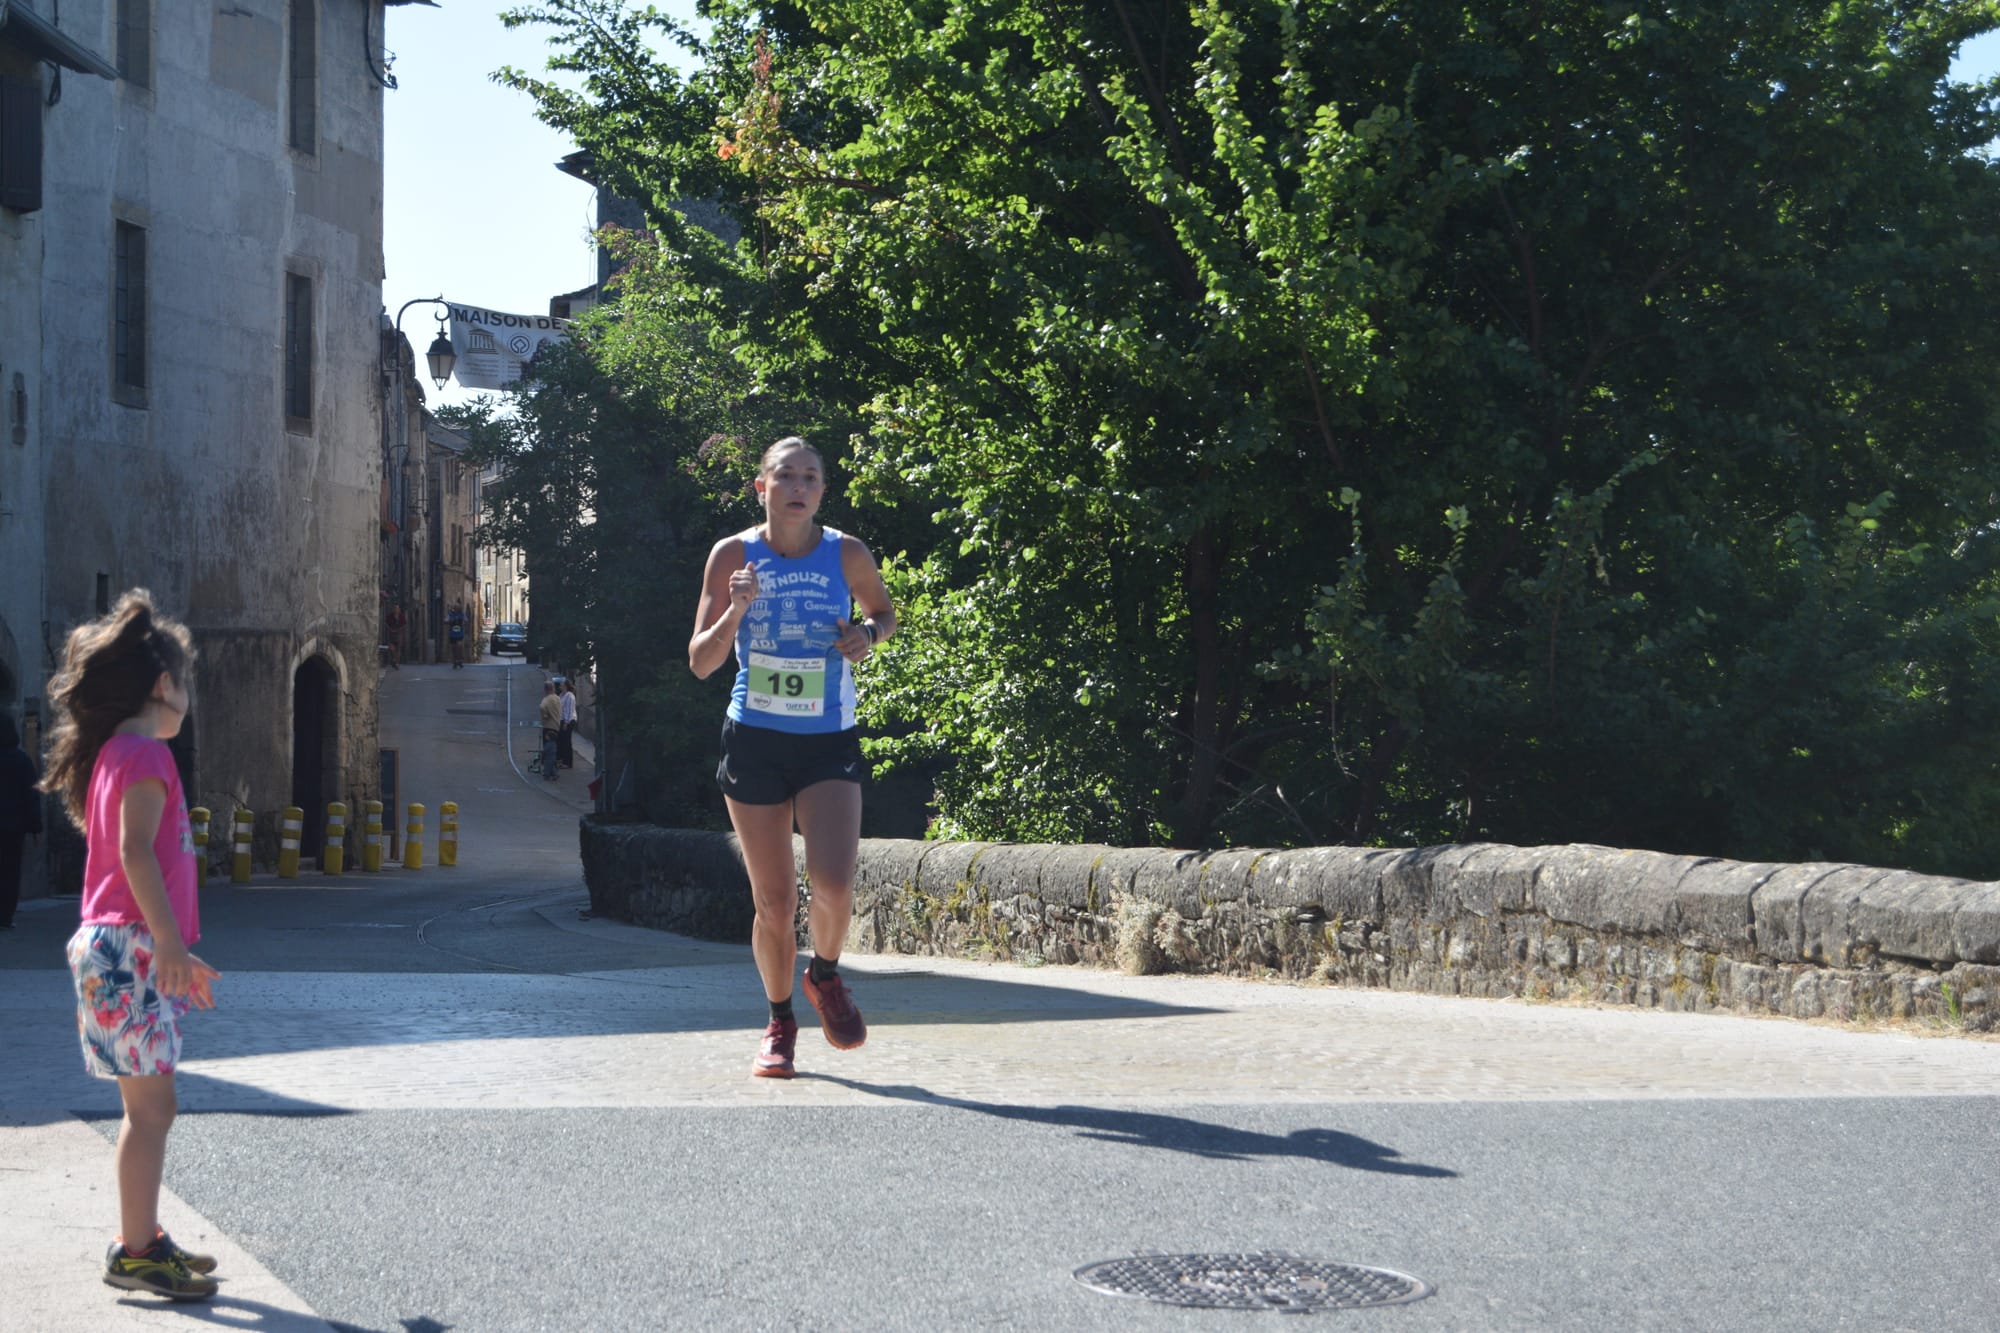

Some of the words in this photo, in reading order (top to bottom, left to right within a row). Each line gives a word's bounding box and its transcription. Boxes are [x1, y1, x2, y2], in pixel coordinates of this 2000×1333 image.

[454, 308, 531, 328] MAISON
[537, 318, 562, 330] DE
[767, 672, 804, 697] 19
